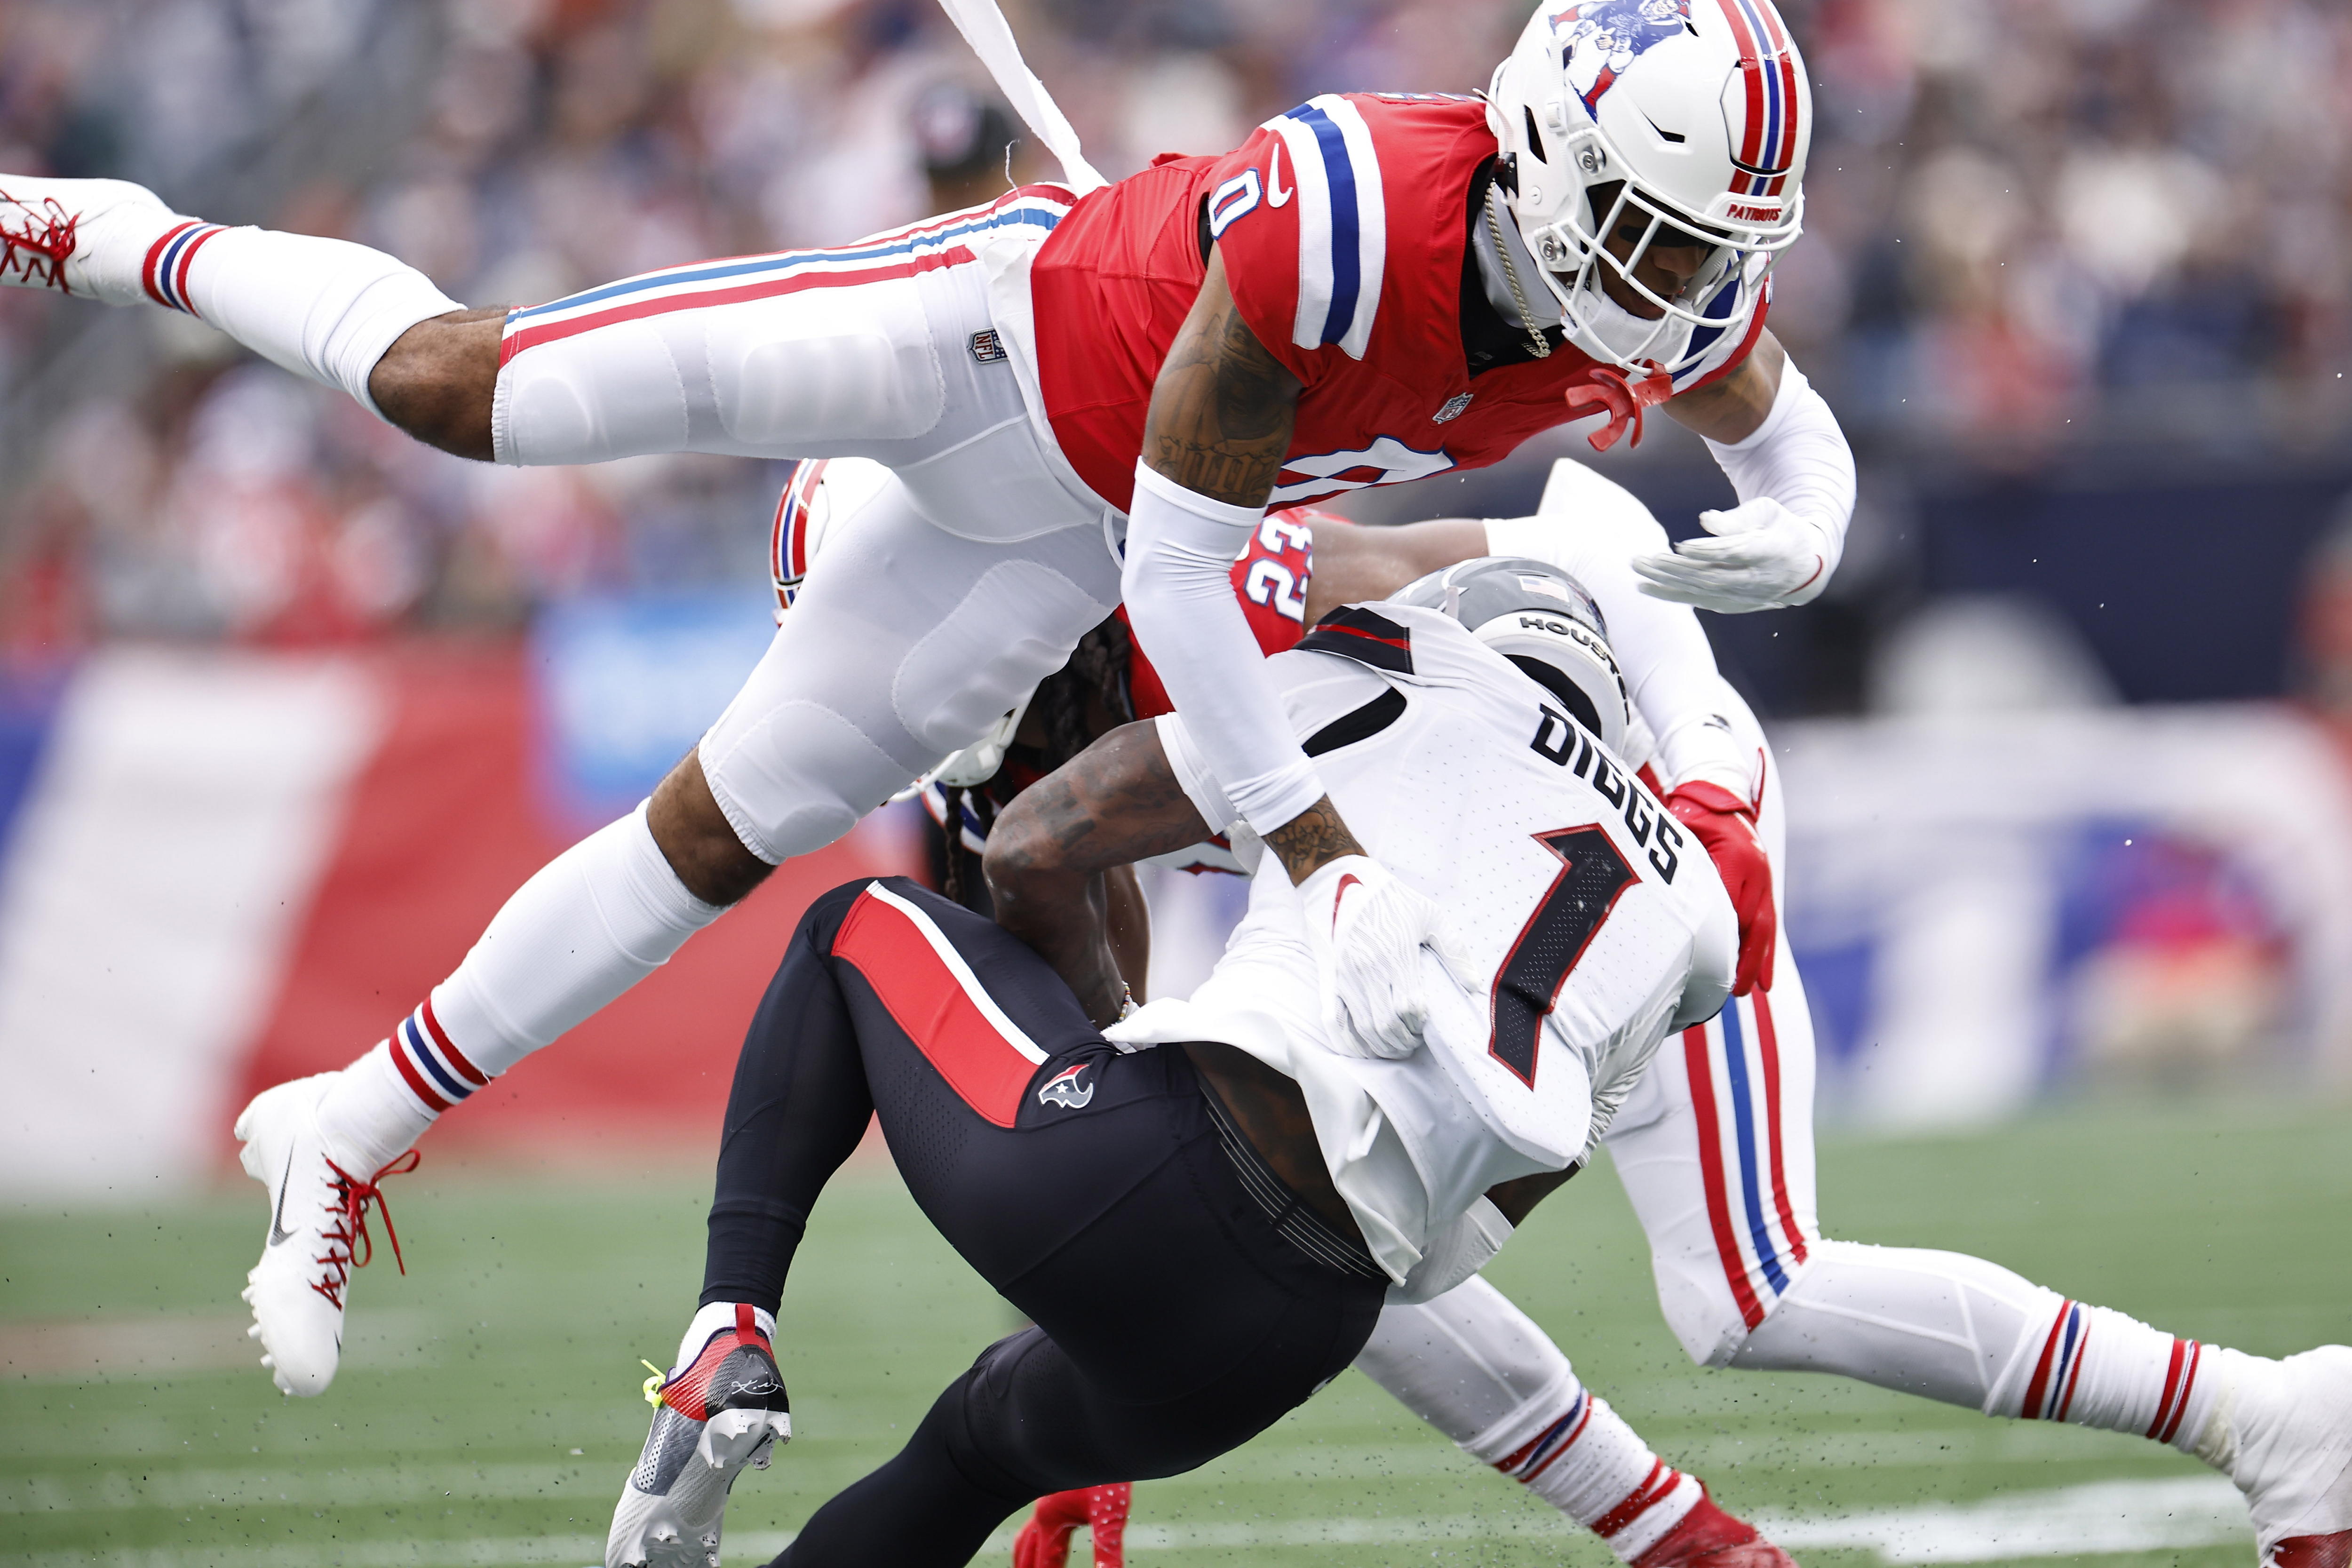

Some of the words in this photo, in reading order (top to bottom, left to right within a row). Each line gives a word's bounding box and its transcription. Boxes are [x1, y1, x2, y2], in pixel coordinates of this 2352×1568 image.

[1208, 167, 1264, 240] 0
[1726, 203, 1782, 222] PATRIOTS
[975, 334, 994, 359] NFL
[1243, 517, 1314, 625] 23
[1530, 703, 1683, 885] DIGGS
[1488, 822, 1643, 1092] 1
